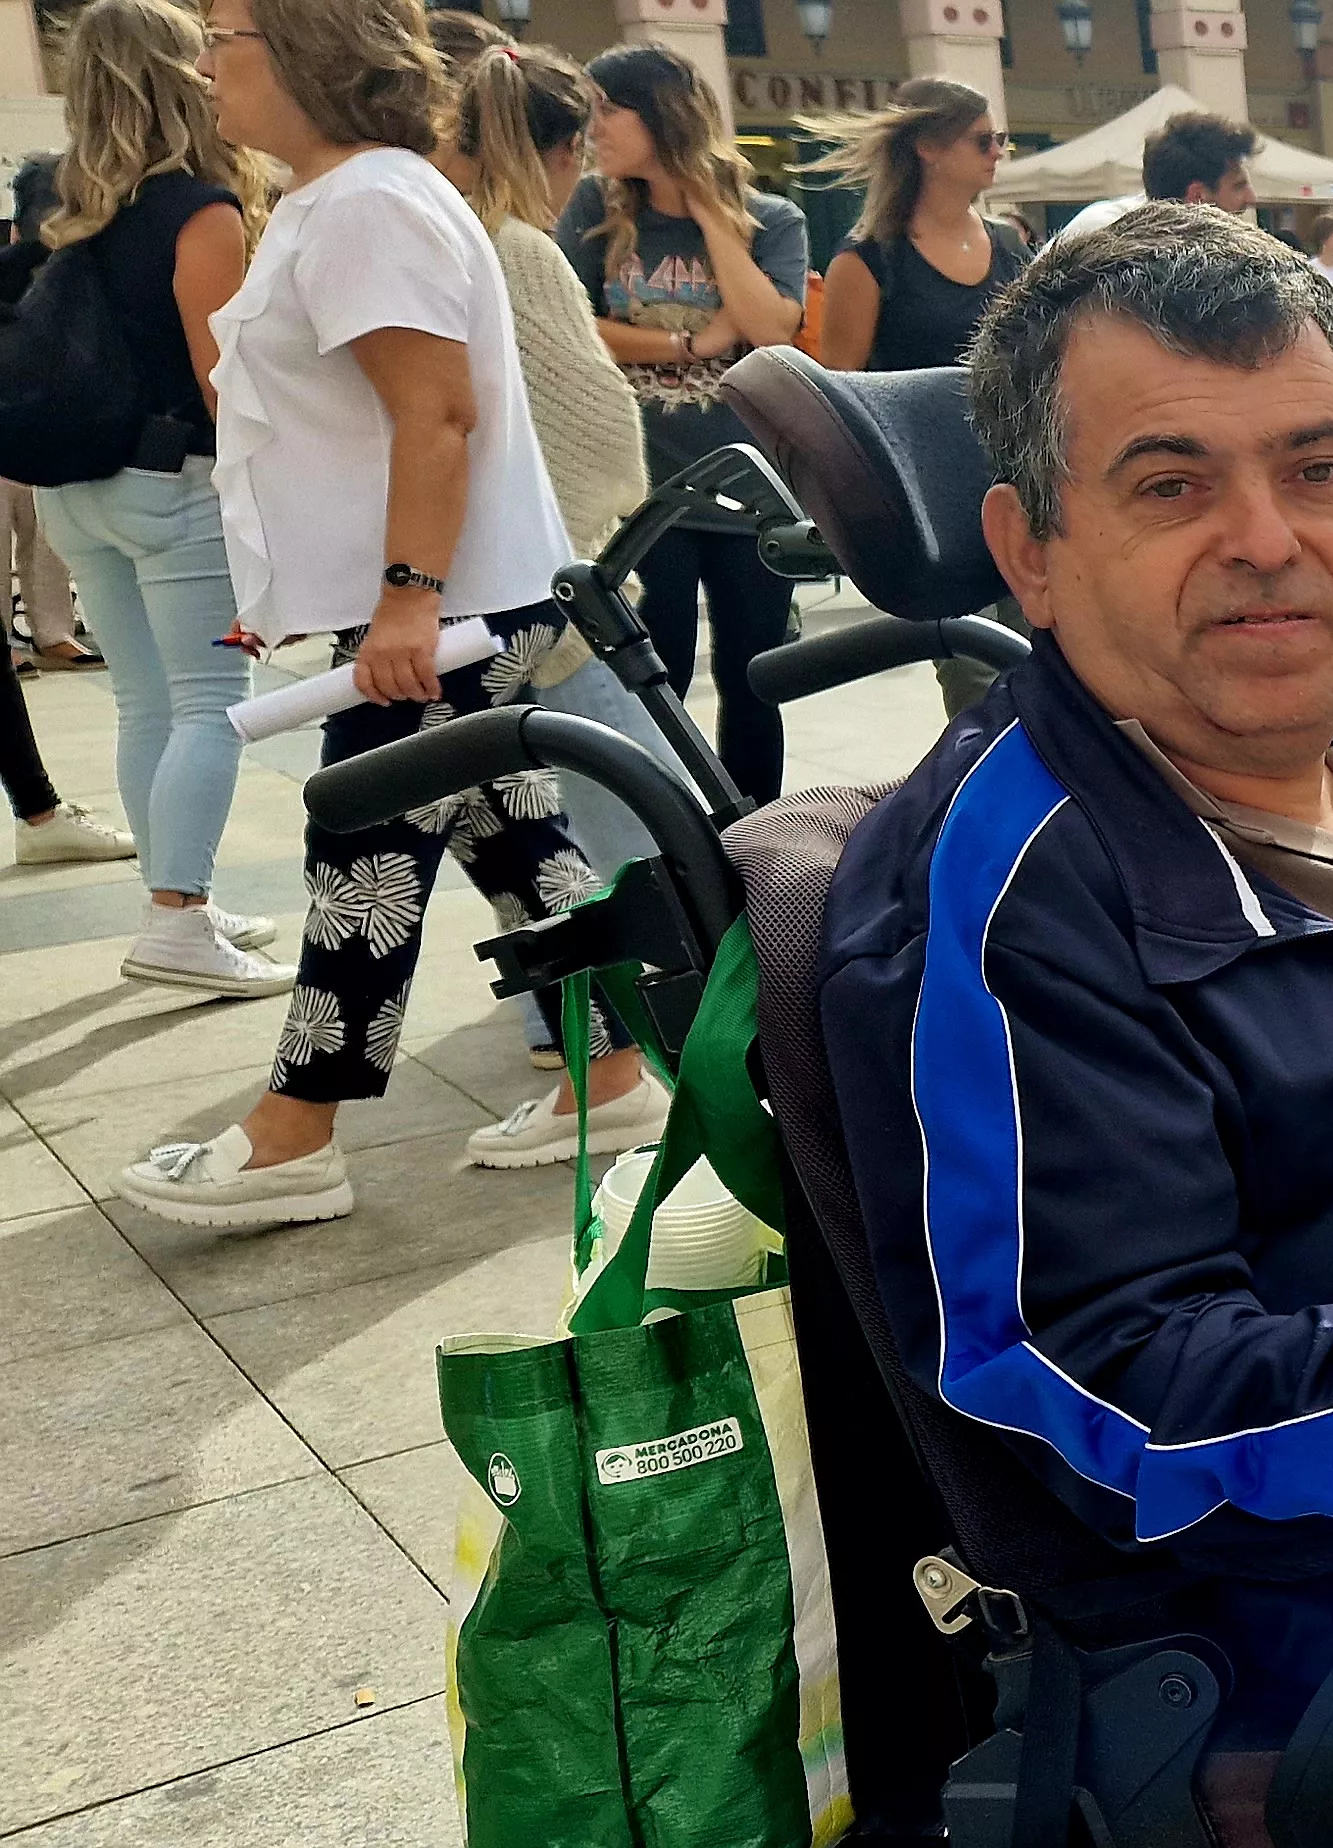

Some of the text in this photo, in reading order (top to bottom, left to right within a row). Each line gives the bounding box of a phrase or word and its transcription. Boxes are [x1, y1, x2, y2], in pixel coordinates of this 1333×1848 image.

[736, 69, 899, 112] CONFI
[634, 1423, 733, 1459] MERCADONA
[636, 1434, 736, 1474] 800 500 220
